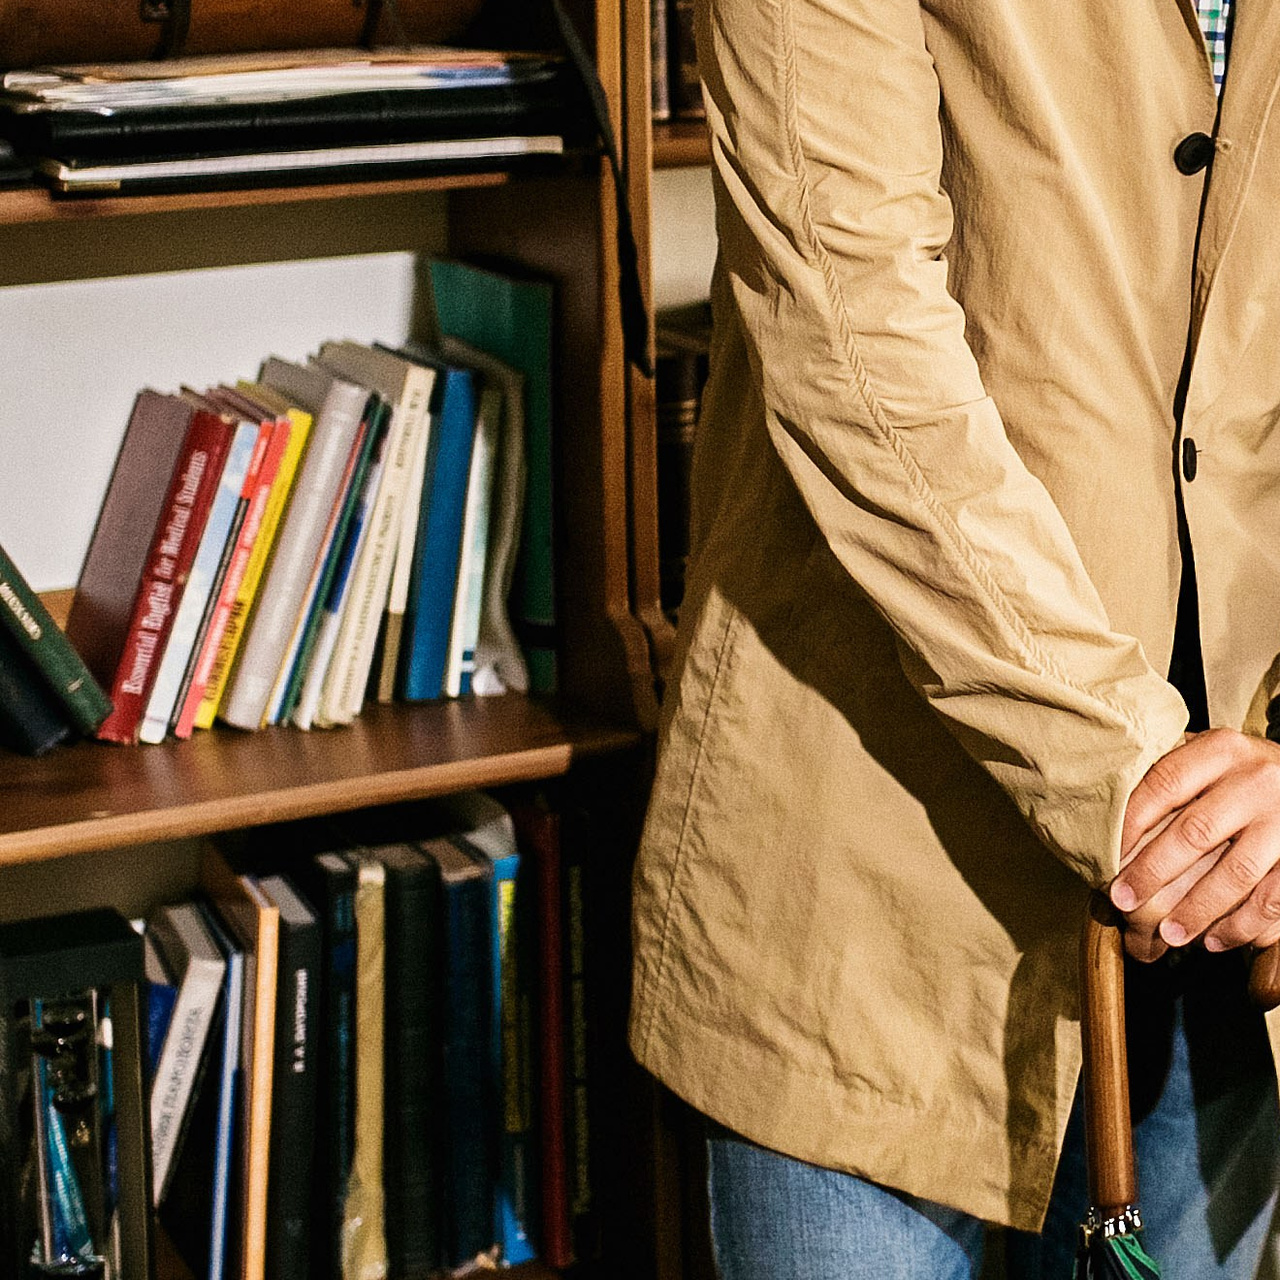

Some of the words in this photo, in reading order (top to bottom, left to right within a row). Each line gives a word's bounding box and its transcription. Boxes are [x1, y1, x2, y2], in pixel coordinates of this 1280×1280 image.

[176, 449, 207, 506] Students
[160, 503, 192, 557] Medical
[153, 555, 176, 580] for
[141, 580, 175, 631] English
[122, 631, 158, 695] Essential
